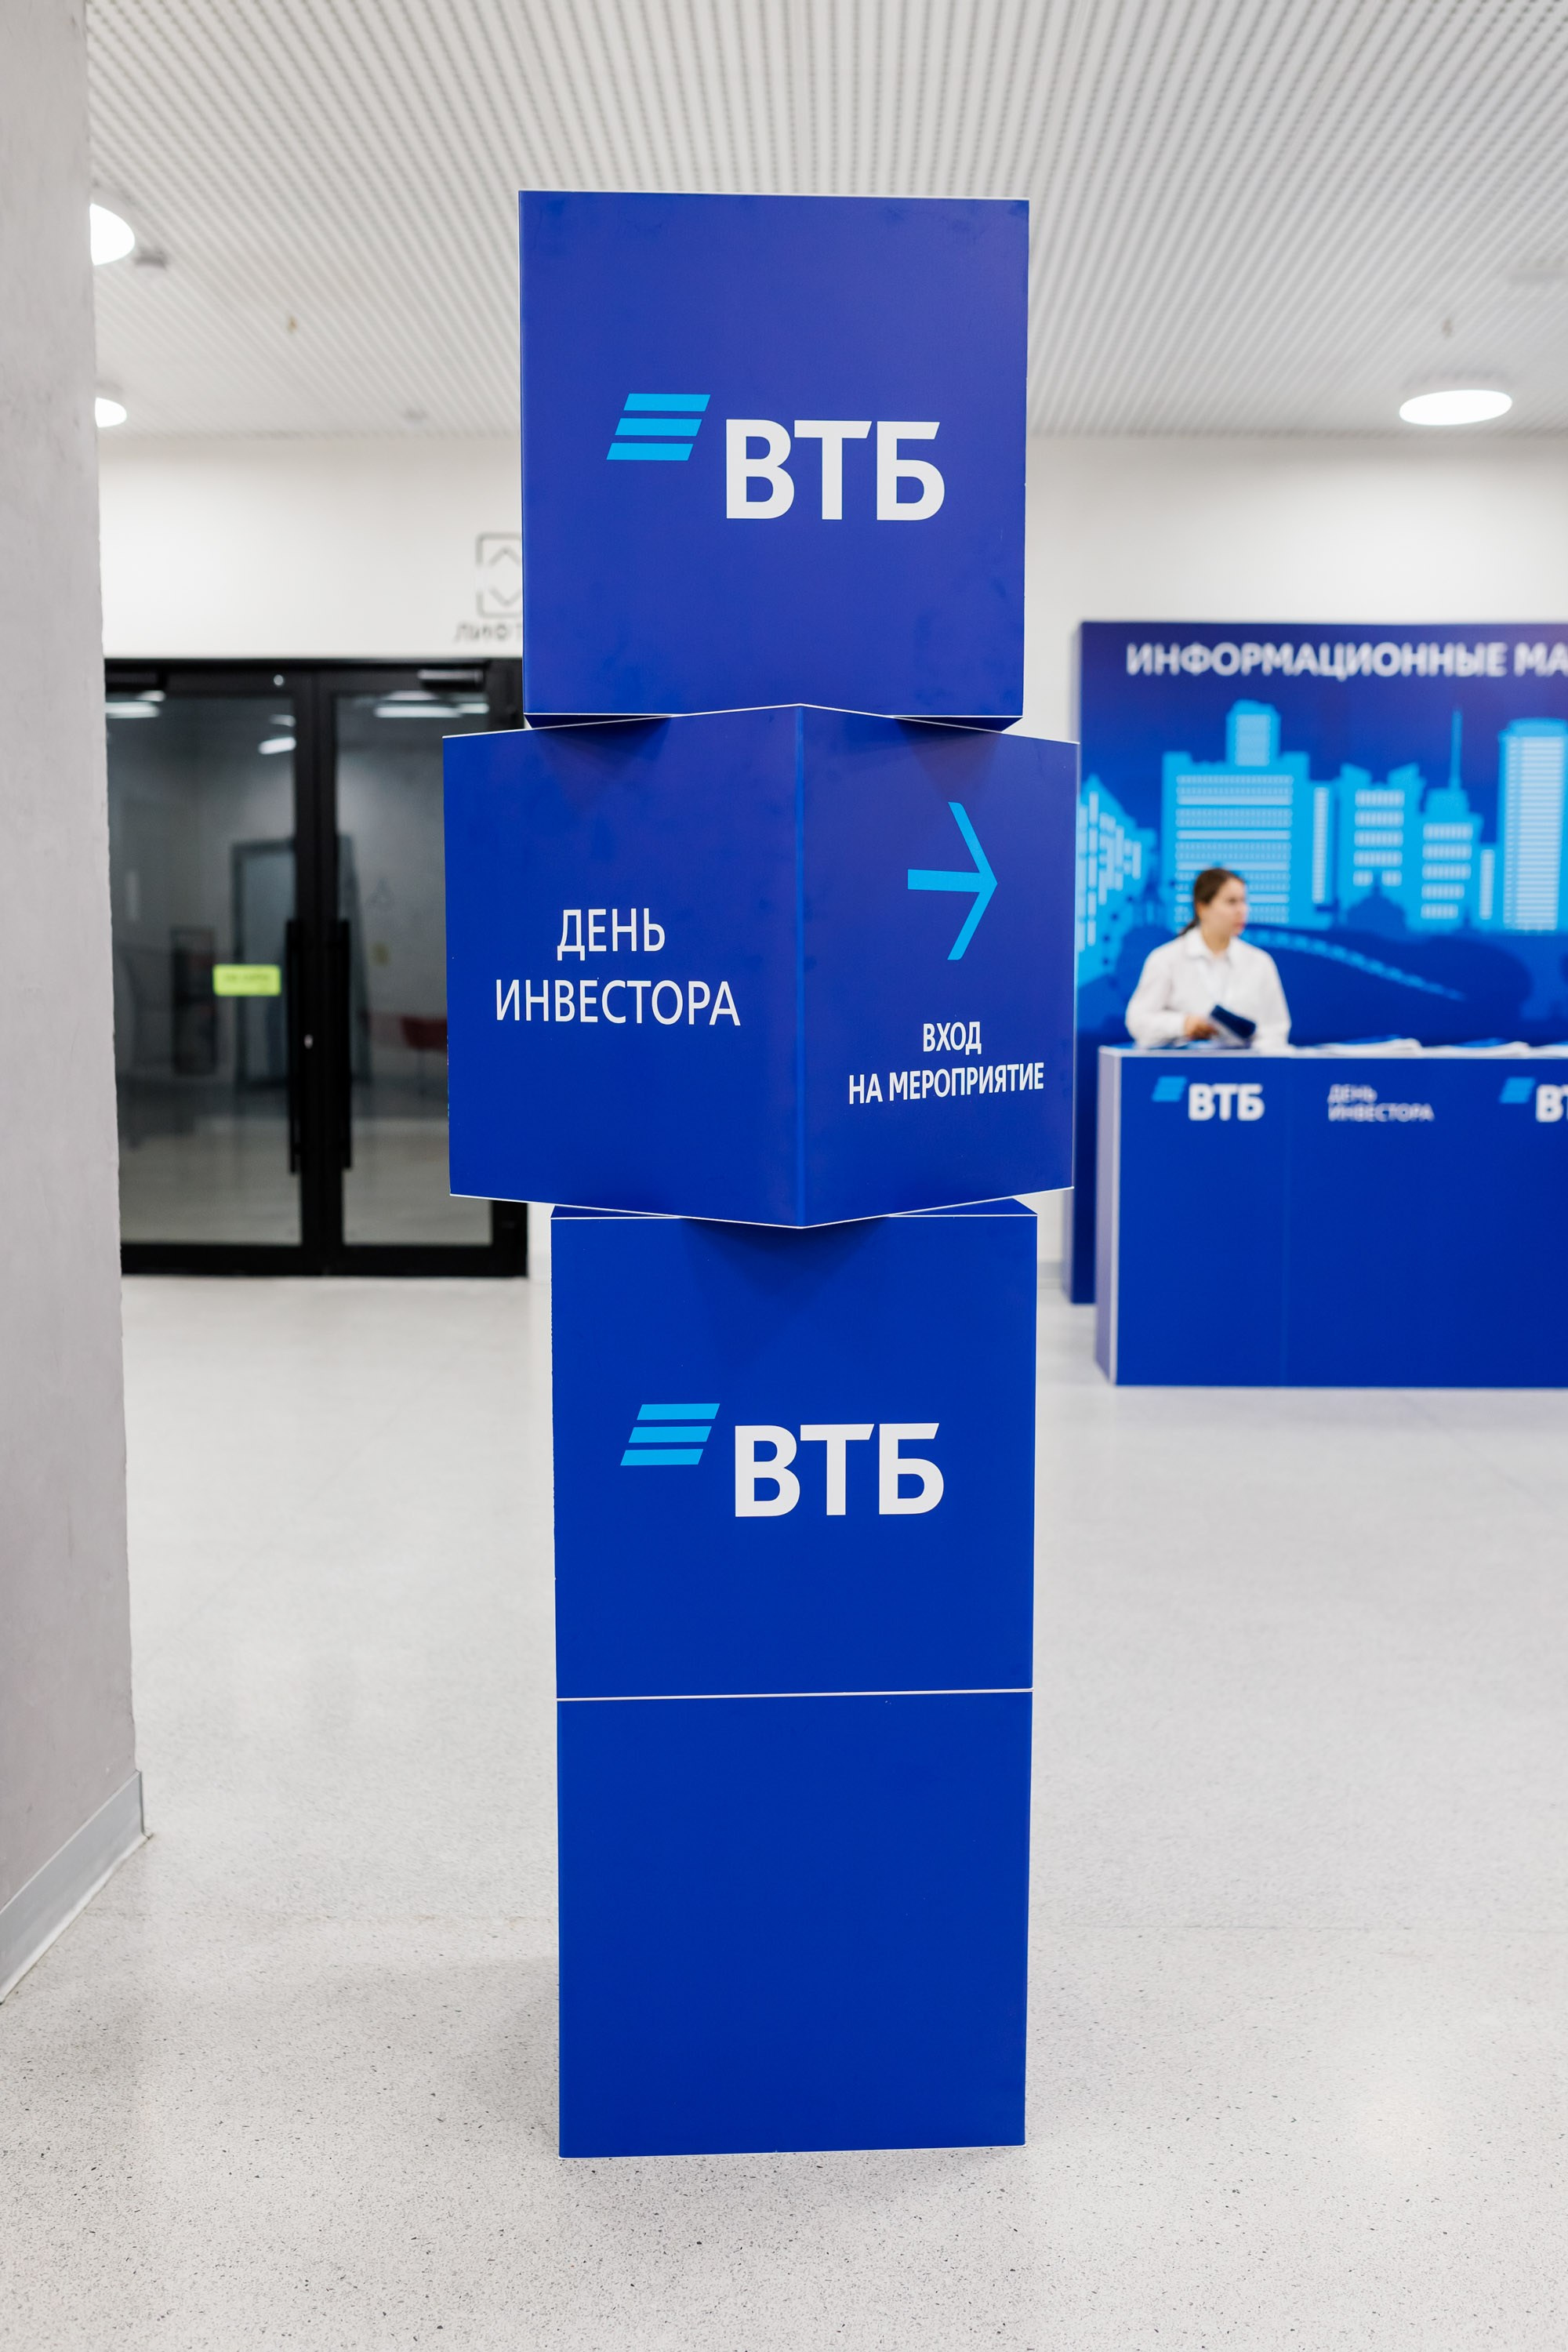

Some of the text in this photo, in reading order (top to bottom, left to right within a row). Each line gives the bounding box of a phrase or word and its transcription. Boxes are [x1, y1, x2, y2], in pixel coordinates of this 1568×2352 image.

[727, 419, 945, 521] ВТБ
[1127, 641, 1568, 680] ИНФОРМАЦИОННЫЕ МА
[557, 909, 665, 960] ДЕНЬ
[495, 979, 740, 1025] ИНВЕСТОРА
[923, 1021, 982, 1055] ВХОД
[849, 1062, 1044, 1104] НА МЕРОПРИЯТИЕ
[1189, 1083, 1265, 1121] ВТБ
[1327, 1084, 1377, 1104] ДЕНЬ
[1328, 1103, 1434, 1121] ИНВЕСТОРА
[735, 1423, 944, 1517] ВТБ
